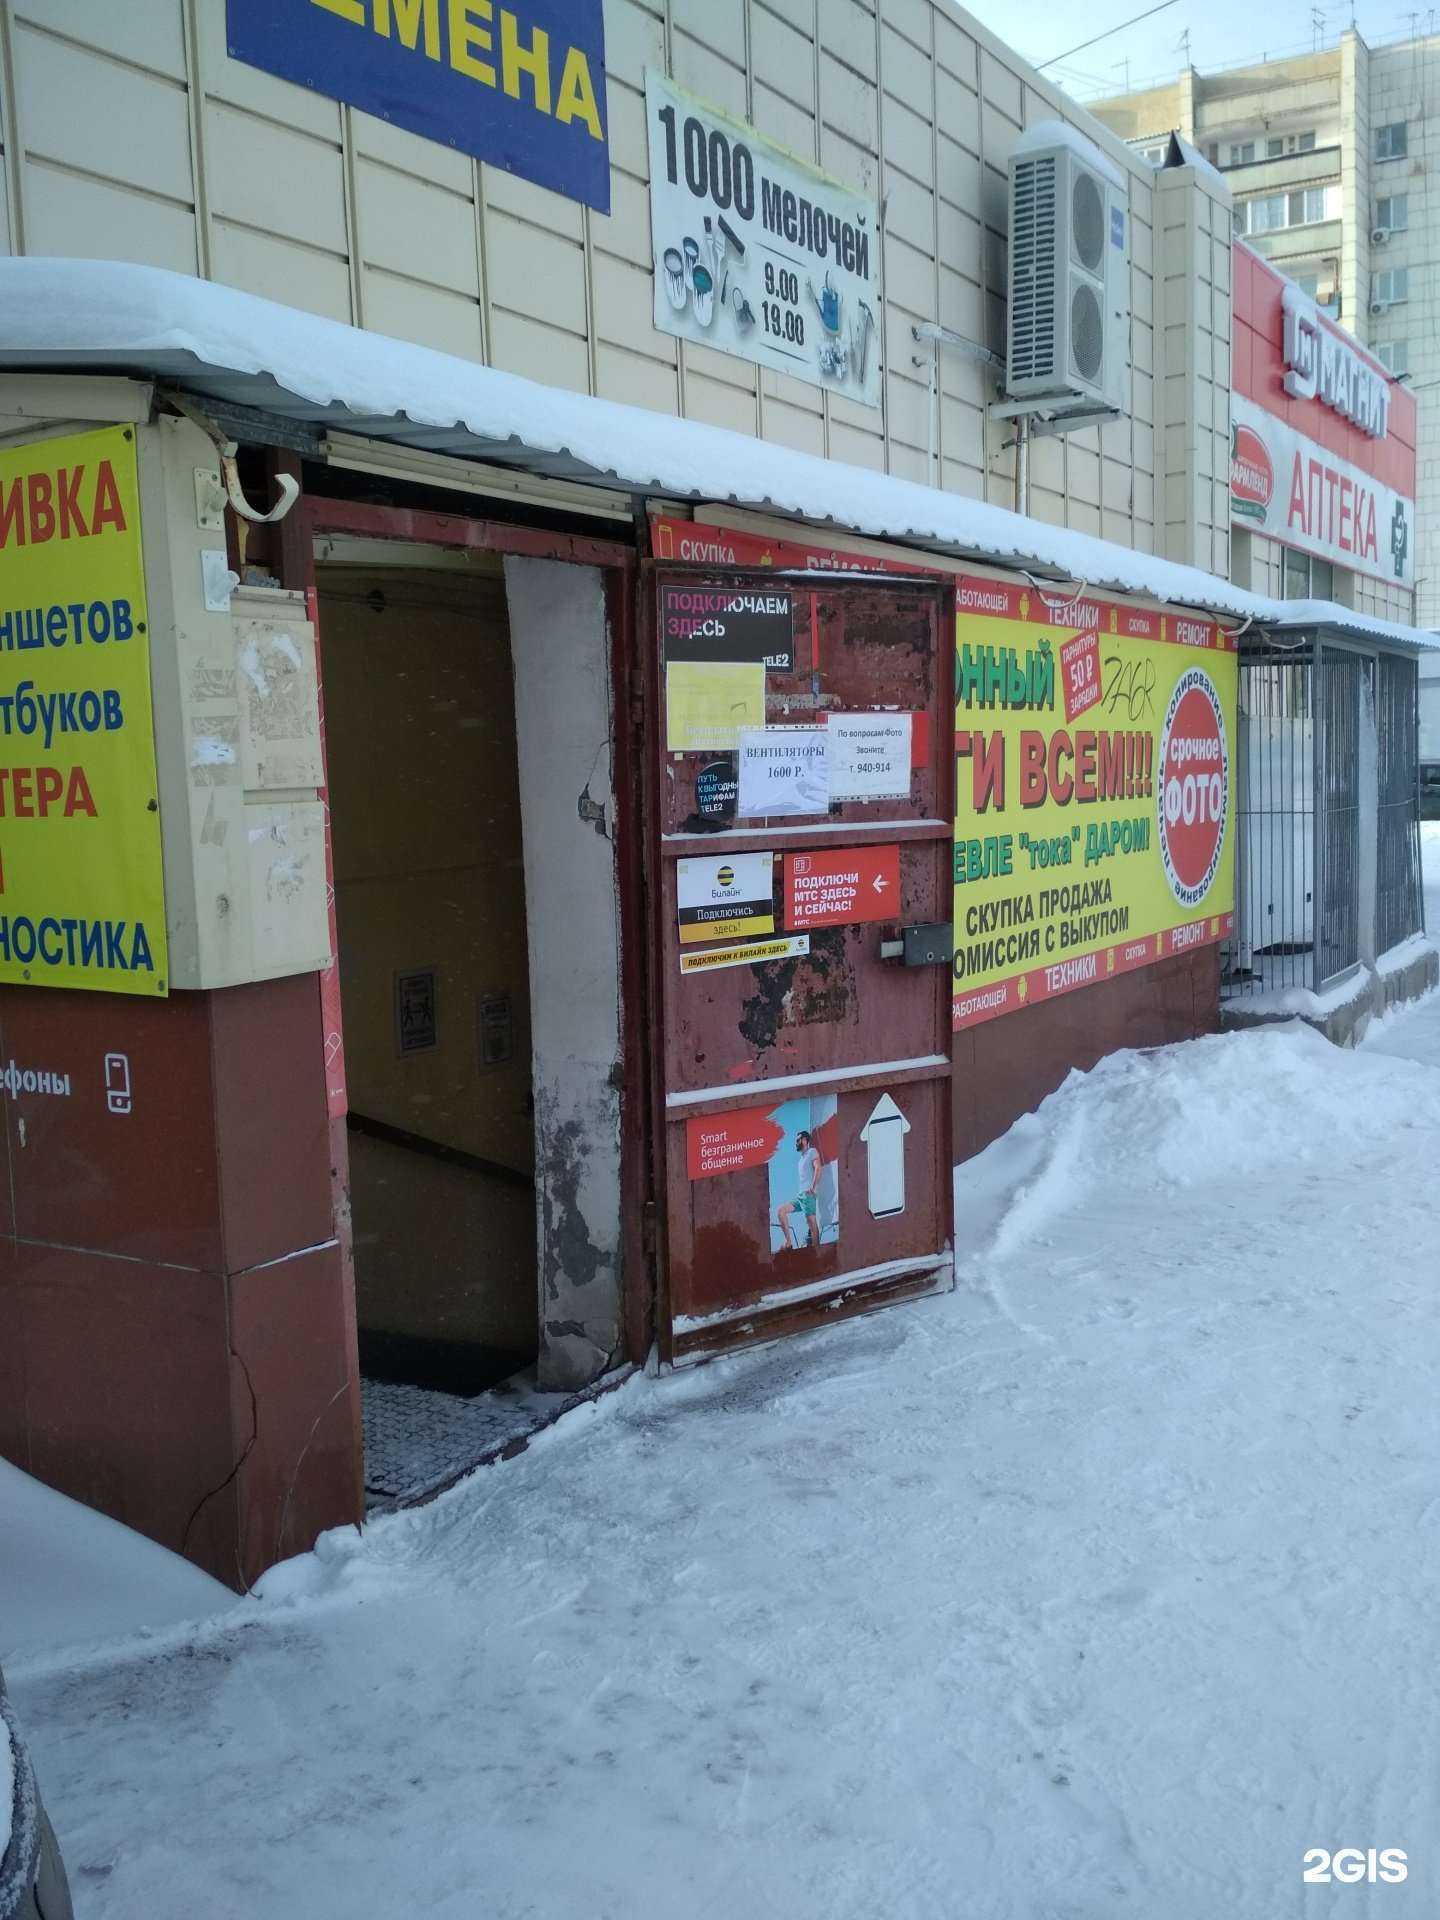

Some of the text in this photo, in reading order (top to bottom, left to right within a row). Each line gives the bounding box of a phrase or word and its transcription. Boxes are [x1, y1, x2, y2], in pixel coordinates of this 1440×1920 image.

[658, 104, 869, 280] 1000 мелочей
[765, 261, 799, 306] 9.00
[761, 300, 805, 346] 19.00
[1320, 330, 1392, 440] МАГНИТ
[1288, 450, 1378, 562] АПТЕКА
[680, 539, 736, 564] СКУПКА
[667, 592, 789, 615] ПОДКЛЮЧАЕМ
[667, 616, 726, 639] ЗДЕСЬ
[1049, 599, 1099, 629] ТЕХНИКИ
[1128, 618, 1151, 633] СКУПКА
[1176, 622, 1211, 647] РЕМОНТ
[1062, 631, 1097, 663] ГАРНИТУРЫ
[762, 653, 790, 667] TELE2
[955, 638, 1055, 711] ННЫЙ
[1070, 660, 1086, 693] 50
[1166, 671, 1223, 730] копирование
[837, 730, 849, 738] По
[746, 746, 825, 759] ВЕНТИЛЯТОРЫ
[855, 745, 885, 755] Звоните
[1171, 738, 1220, 768] срочное
[697, 774, 718, 783] ПУТЬ
[767, 767, 792, 778] 1600
[857, 763, 891, 774] 940-914
[1020, 729, 1153, 808] ВСЕМ!!!
[700, 791, 736, 803] ТАРИФАМ
[701, 803, 724, 813] TELE2
[1165, 772, 1223, 827] ФОТО
[1019, 825, 1081, 869] "тока"
[1085, 817, 1150, 867] ДАРОМ!
[711, 886, 742, 899] Билайн
[794, 873, 859, 890] ПОДКЛЮЧИ
[794, 886, 857, 903] МТС ЗДЕСЬ
[696, 907, 754, 921] Подключись
[794, 901, 852, 916] И СЕЙЧАС!
[965, 878, 1113, 937] СКУПКА ПРОДАЖА
[713, 922, 742, 935] здесь!
[1045, 924, 1055, 953] С
[1060, 906, 1130, 947] ВЫКУПОМ
[688, 951, 733, 967] ПОДКЛЮЧИМ
[732, 952, 739, 961] К
[739, 947, 767, 959] БИЛАЙН
[767, 944, 789, 955] ЗДЕСЬ
[1045, 955, 1097, 992] ТЕХНИКИ
[1126, 944, 1146, 961] СКУПКА
[1171, 921, 1205, 950] РЕМОНТ
[0, 1060, 70, 1099] фоны
[701, 1131, 727, 1145] Smart
[701, 1137, 764, 1158] безграничное
[701, 1154, 744, 1171] общение
